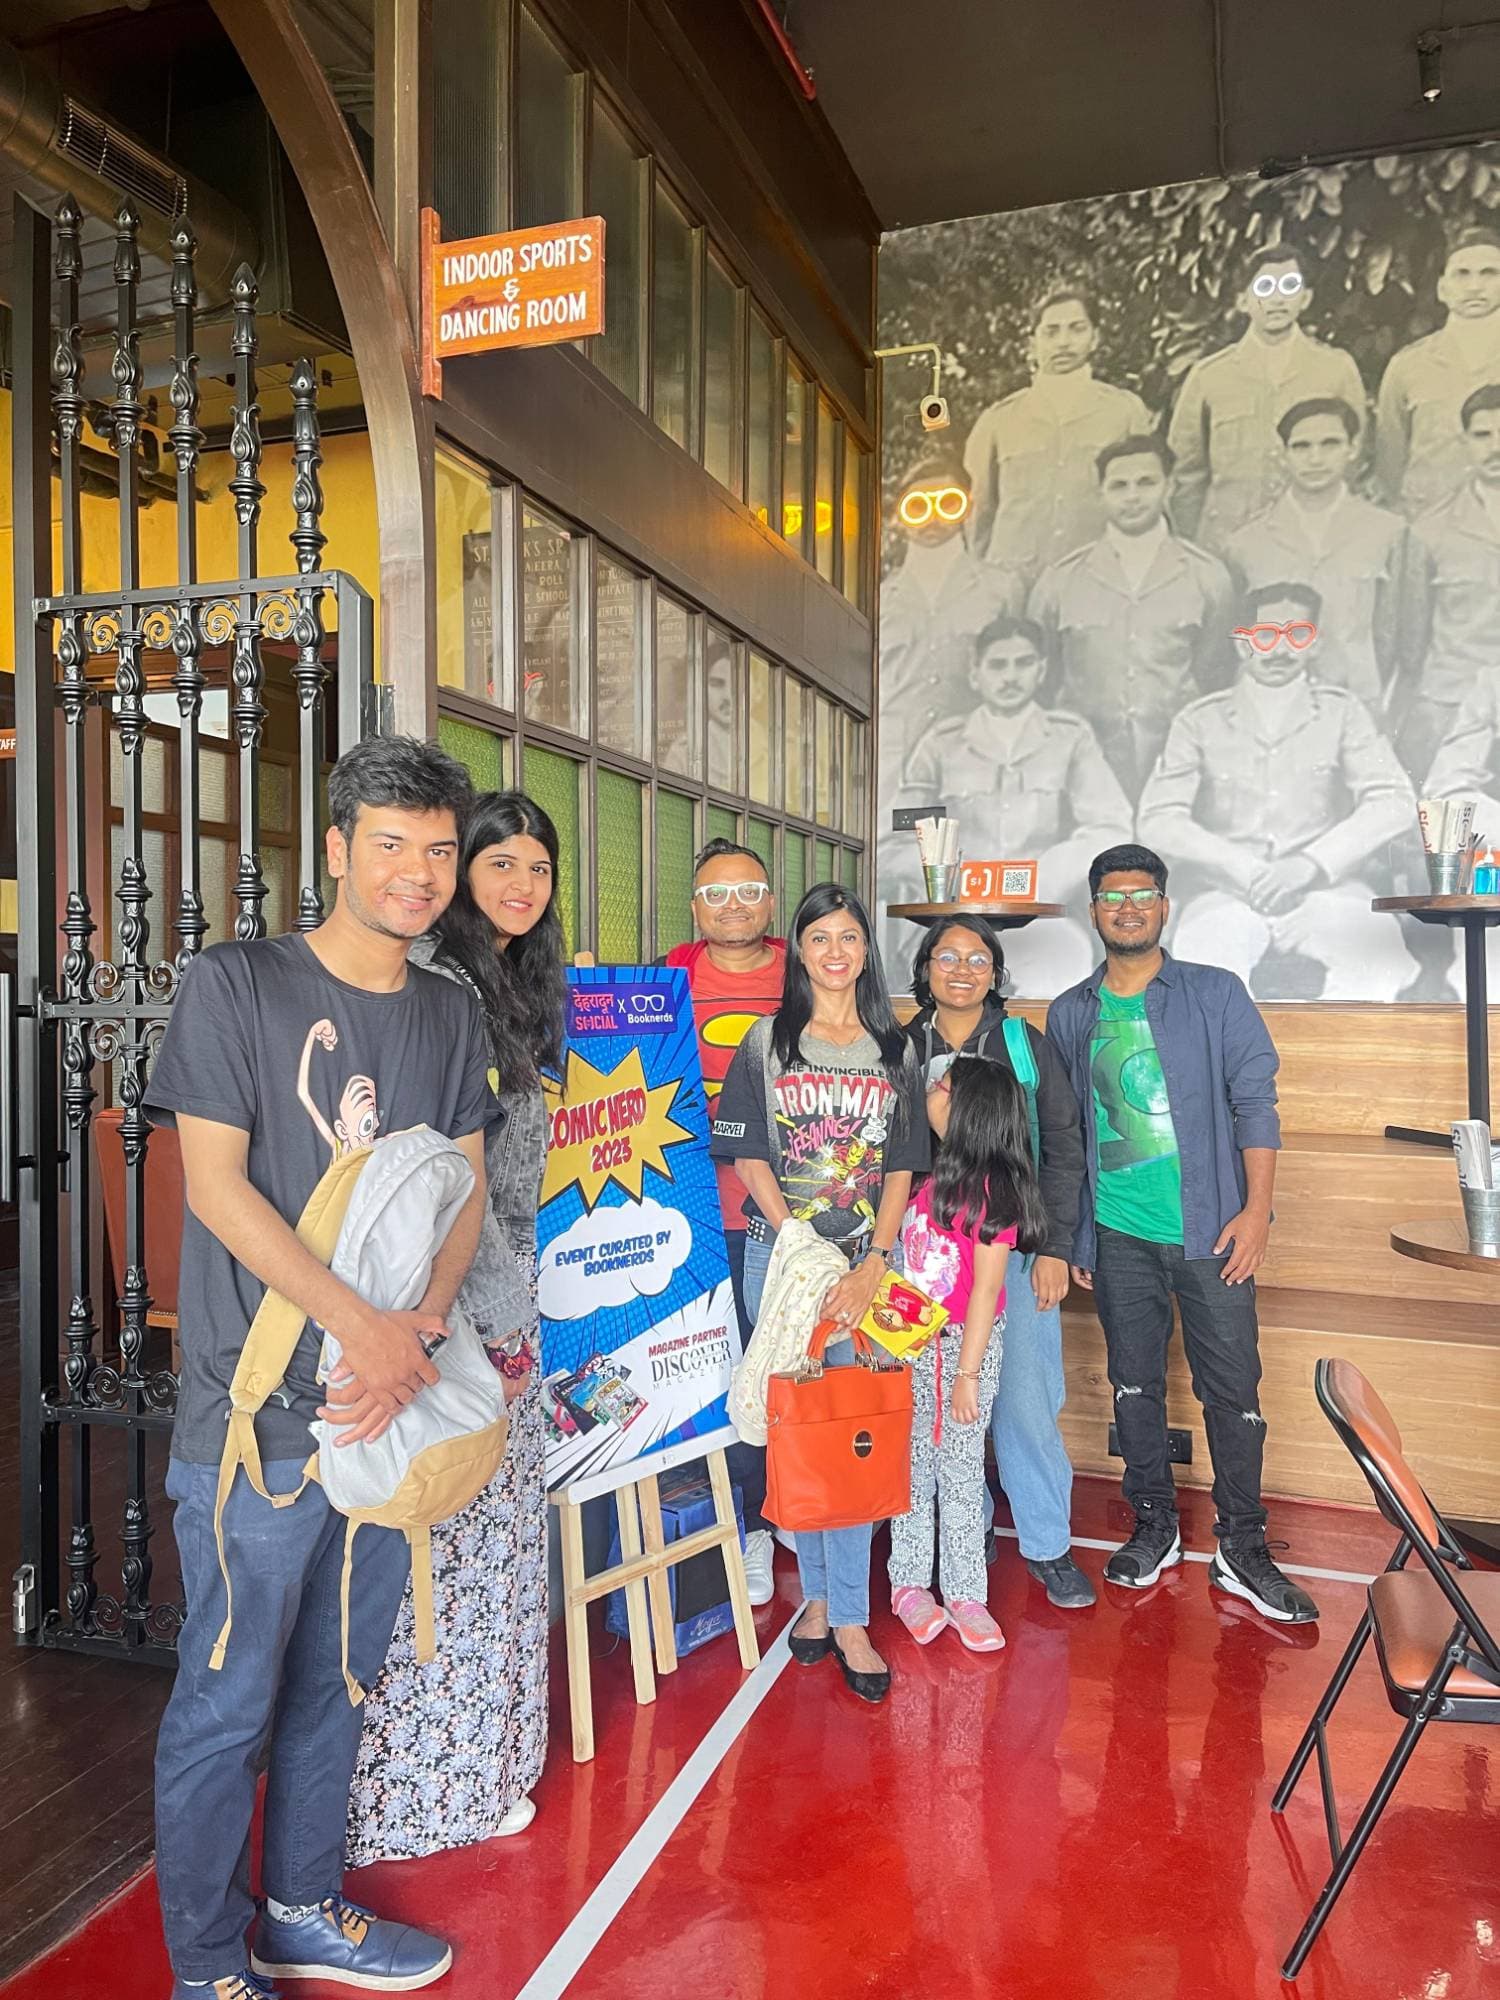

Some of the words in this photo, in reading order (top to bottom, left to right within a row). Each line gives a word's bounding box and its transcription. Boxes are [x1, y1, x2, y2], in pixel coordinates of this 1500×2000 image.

[443, 247, 514, 286] INDOOR
[519, 234, 592, 273] SPORTS
[502, 278, 520, 302] &
[440, 304, 520, 342] DANCING
[526, 290, 587, 328] ROOM
[0, 738, 16, 750] AFF
[627, 1013, 674, 1024] Booknerds
[606, 1086, 647, 1137] NERD
[775, 1073, 834, 1118] IRON
[591, 1136, 633, 1173] 2023
[555, 1245, 595, 1267] EVENT
[599, 1234, 653, 1258] CURATED
[656, 1230, 671, 1246] BY
[584, 1249, 655, 1277] BOOKNERDS
[648, 1335, 690, 1358] MAGAZINE
[691, 1325, 728, 1346] PARTNER
[651, 1340, 732, 1382] DISCOVER
